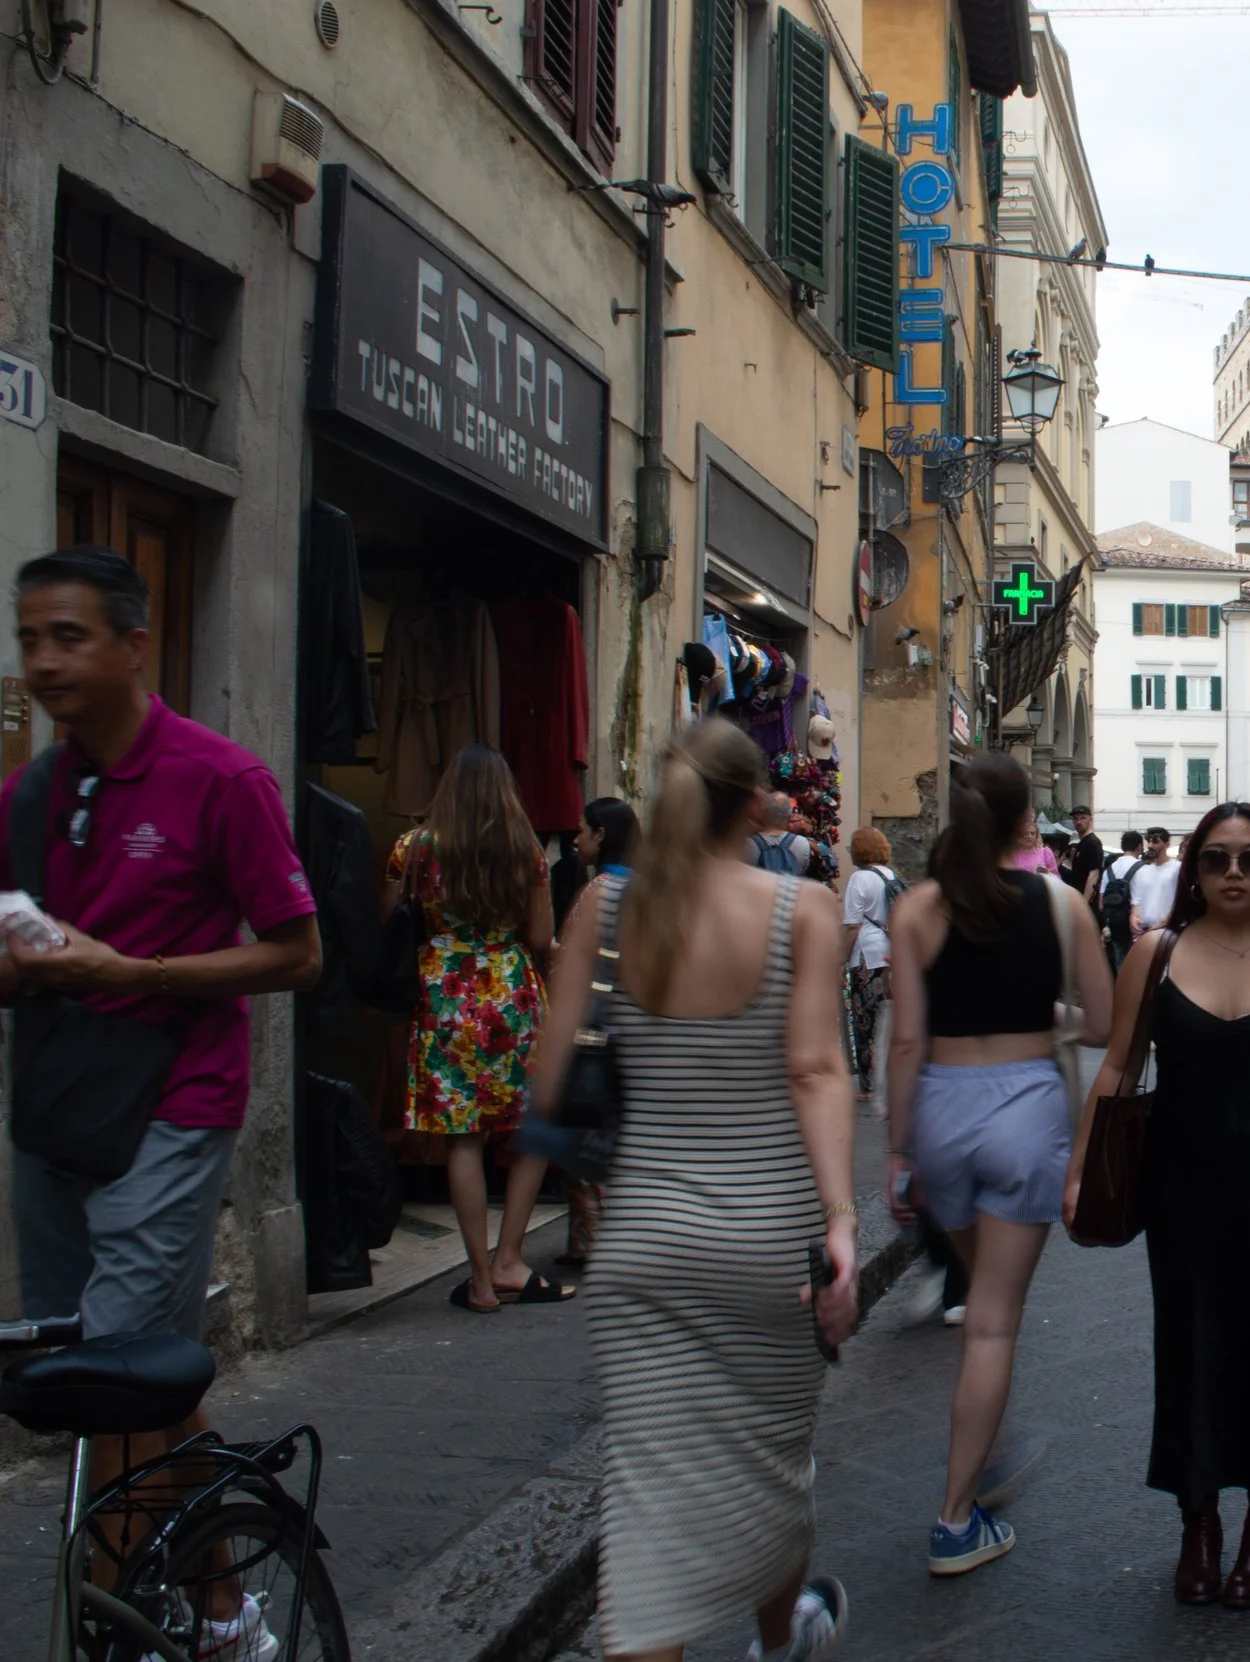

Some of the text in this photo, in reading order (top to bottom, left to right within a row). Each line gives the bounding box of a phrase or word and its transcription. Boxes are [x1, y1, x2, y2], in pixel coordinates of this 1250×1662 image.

[893, 103, 954, 405] HOTEL
[357, 339, 593, 518] TUSCAN LEATHER FACTORY
[416, 257, 563, 445] ESTRO
